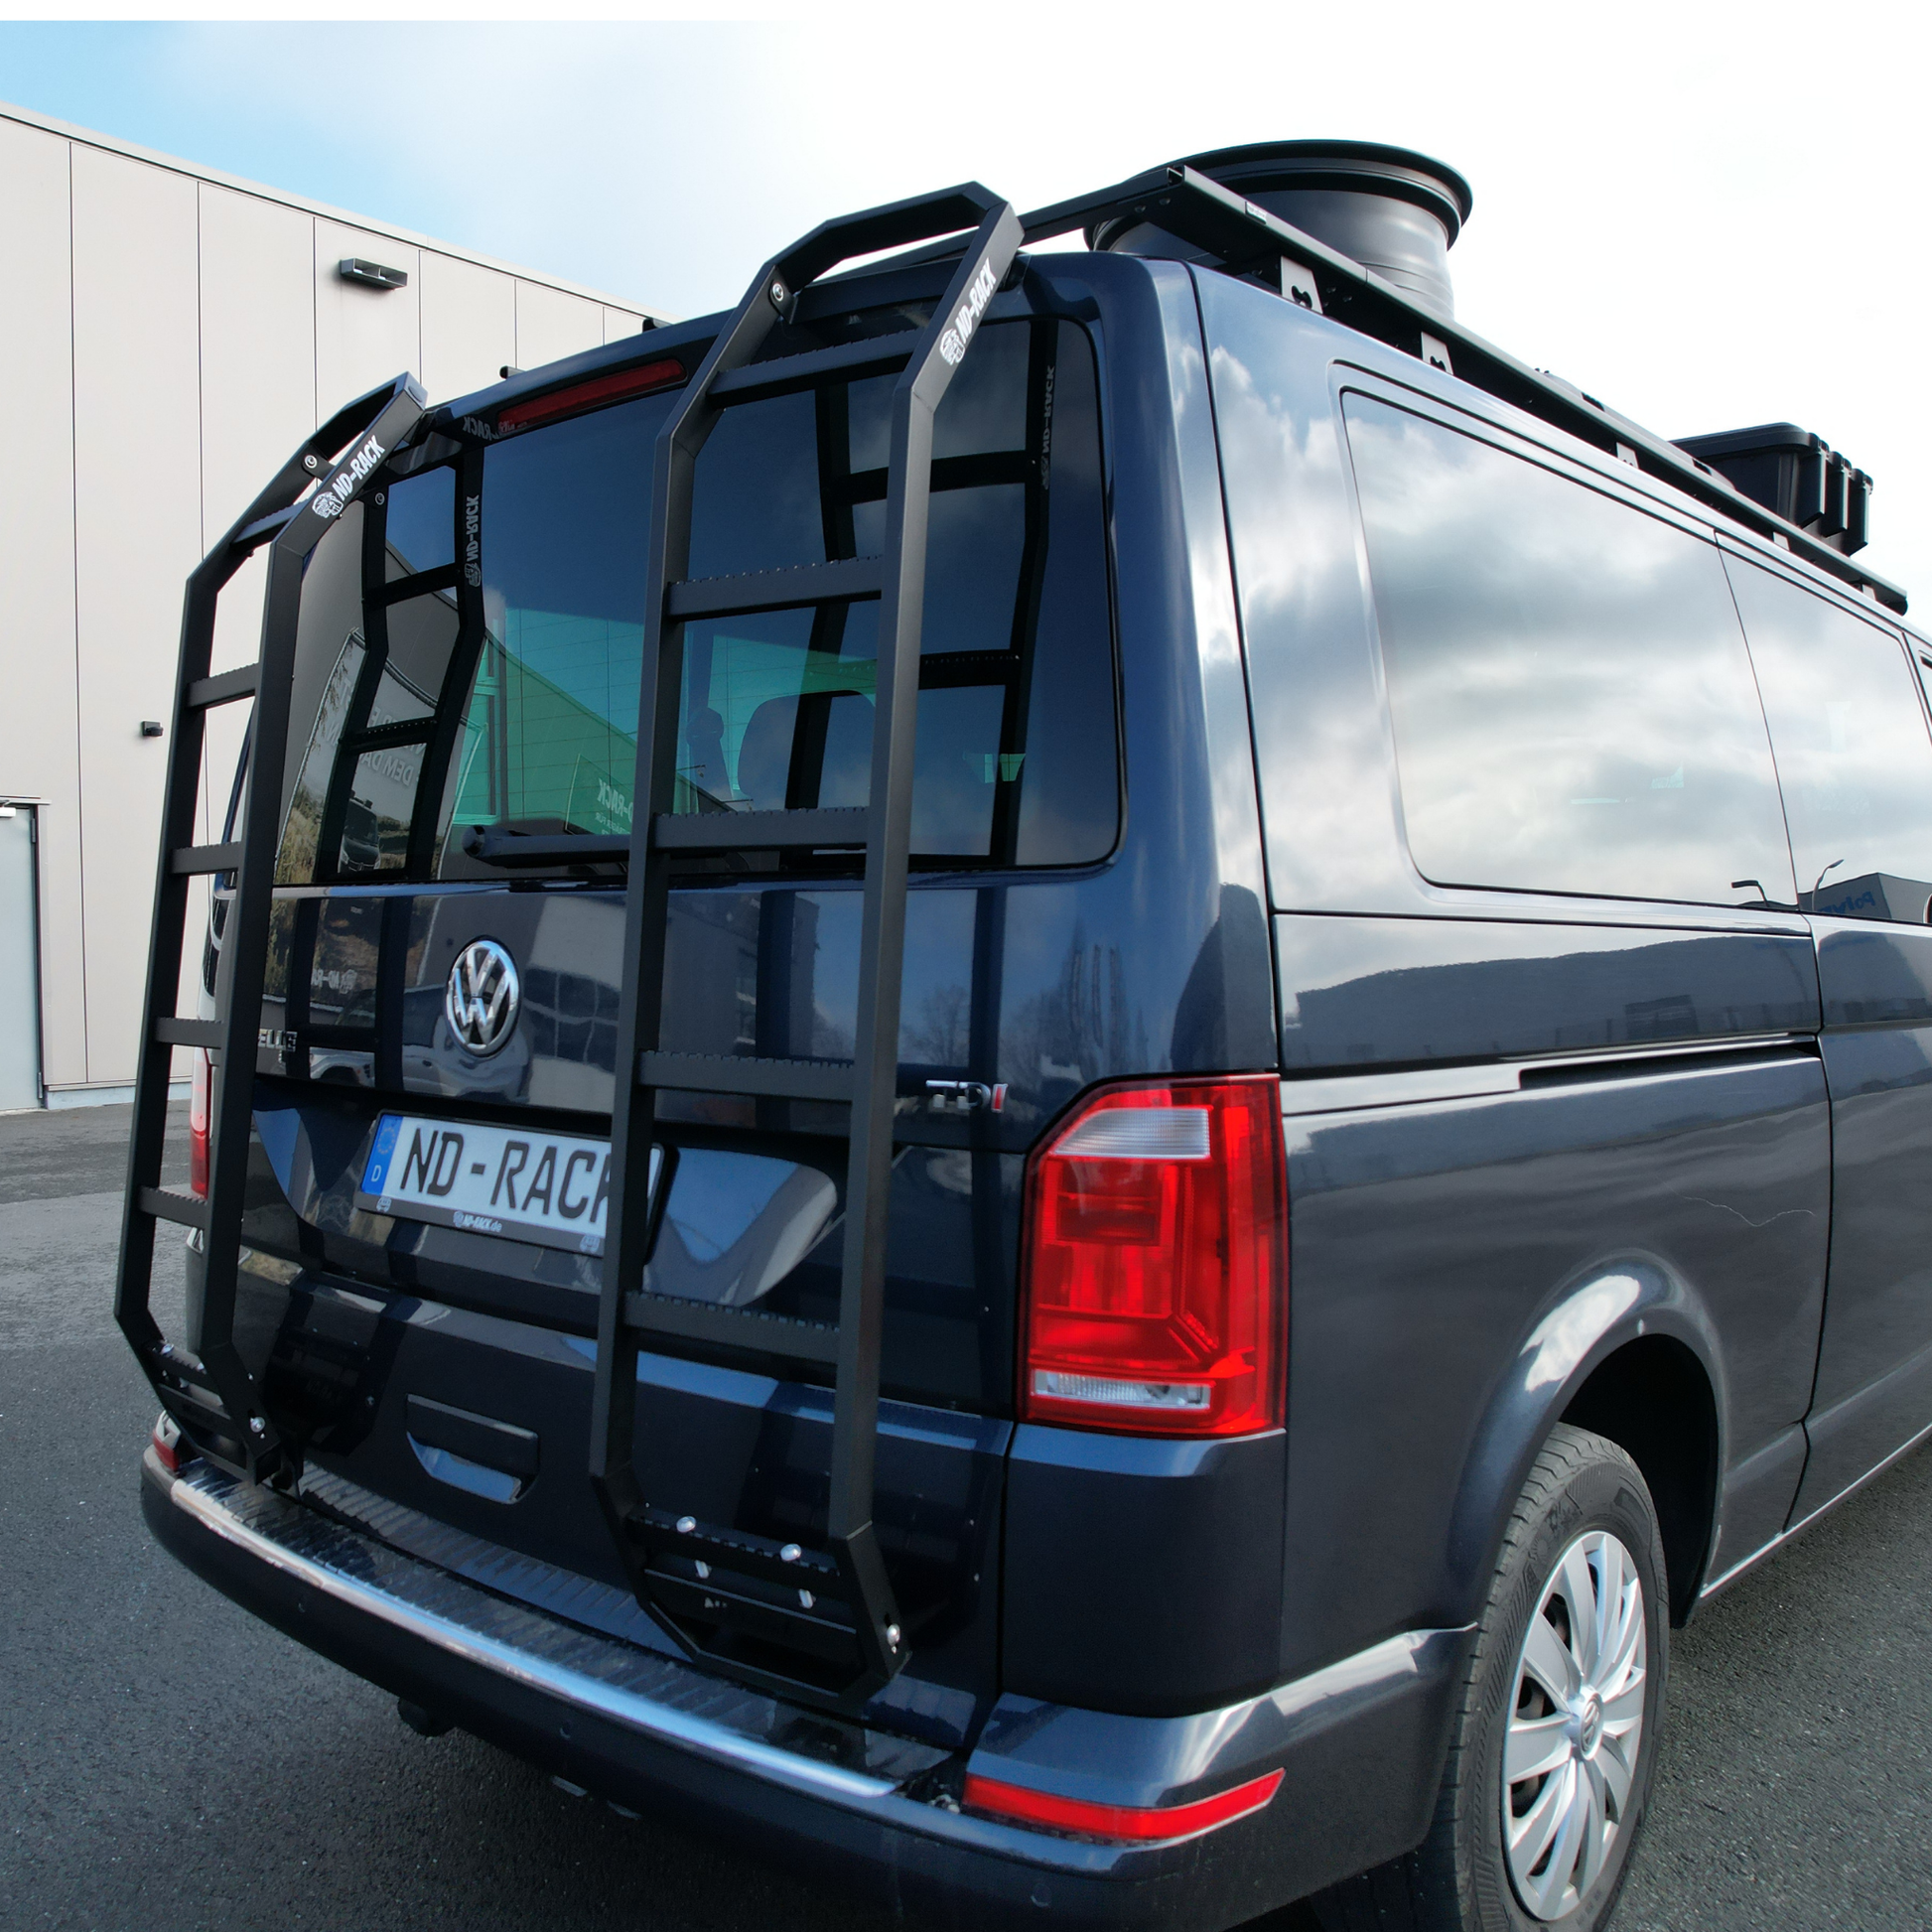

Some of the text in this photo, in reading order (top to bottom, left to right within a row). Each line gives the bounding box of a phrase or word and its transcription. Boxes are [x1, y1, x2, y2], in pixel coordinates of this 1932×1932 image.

[955, 257, 996, 344] ND-RACK
[332, 435, 385, 501] ND-RACK
[925, 1079, 1009, 1112] TDI
[370, 1165, 382, 1182] D
